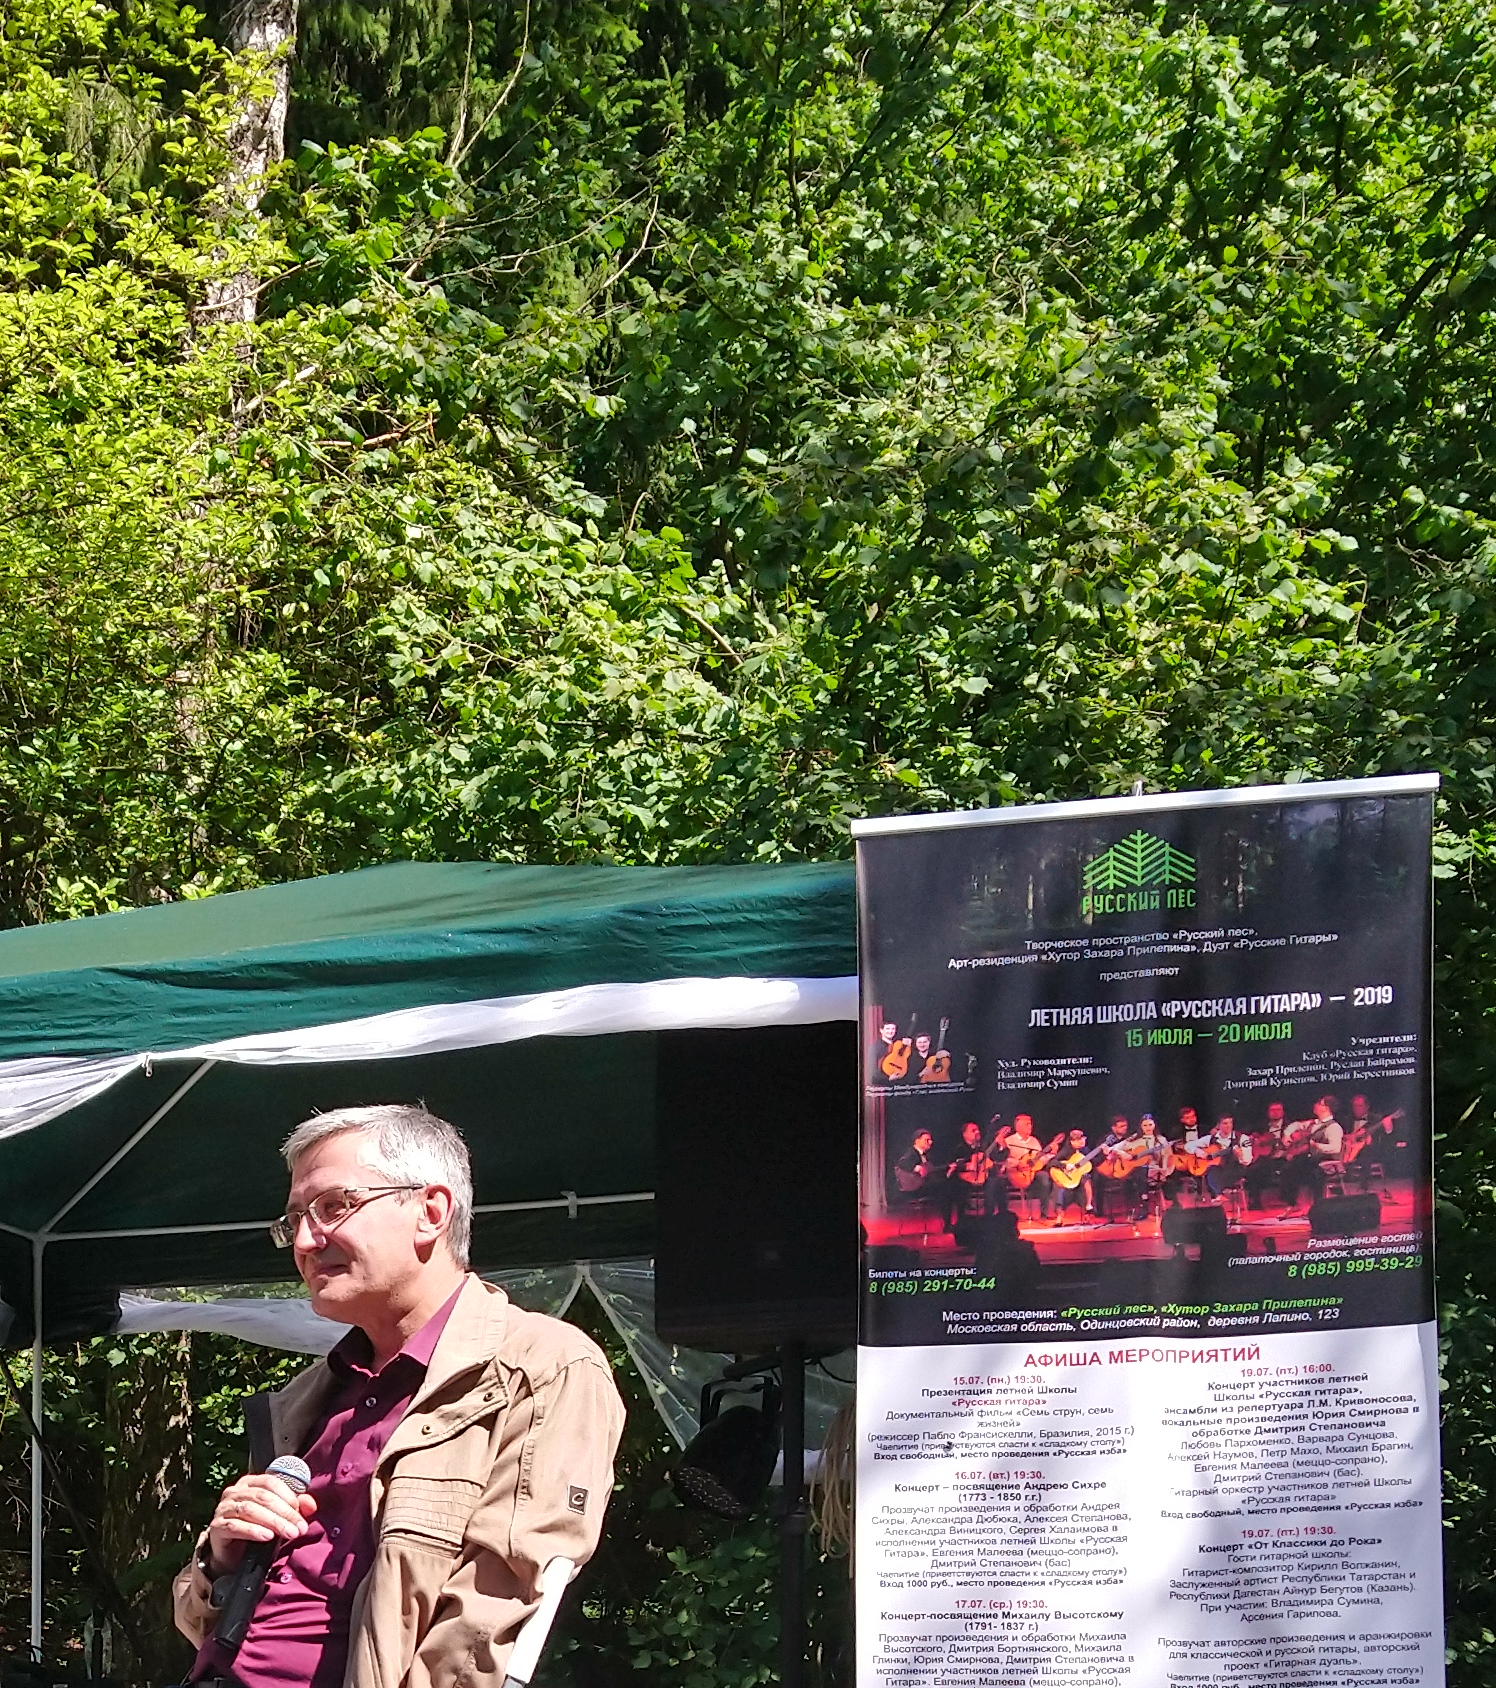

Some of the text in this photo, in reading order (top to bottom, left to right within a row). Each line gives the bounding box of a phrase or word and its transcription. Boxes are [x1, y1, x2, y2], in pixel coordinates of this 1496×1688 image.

[1081, 888, 1196, 915] РУССКИЙ ЛЕС
[1024, 938, 1088, 951] Творческое
[1092, 932, 1169, 947] пространство
[1172, 927, 1224, 942] «Русский
[948, 954, 1037, 970] Арт-резиденция
[1041, 951, 1080, 963] «Хутор
[1083, 948, 1123, 959] Захара
[1202, 940, 1229, 953] Дуэт
[1233, 937, 1285, 950] «Русские
[1289, 931, 1337, 945] Гитары»
[1099, 966, 1180, 982] представляют
[1028, 1004, 1092, 1028] ЛЕТНЯЯ
[1096, 1000, 1156, 1023] ШКОЛА
[1161, 994, 1246, 1019] «РУССКАЯ
[1250, 989, 1321, 1013] ГИТАРА»
[1353, 984, 1392, 1007] 2019
[1124, 1028, 1143, 1048] 15
[1145, 1026, 1192, 1047] ИЮЛЯ
[1216, 1023, 1240, 1043] 20
[1243, 1021, 1292, 1042] ИЮЛЯ
[1227, 1251, 1301, 1268] (палаточный
[868, 1268, 976, 1279] Билеты на концерты:
[1287, 1264, 1297, 1278] 8
[1301, 1261, 1340, 1278] (985)
[867, 1277, 995, 1295] 8 (985) 291-70-44
[942, 1311, 980, 1322] Место
[982, 1308, 1057, 1322] проведения:
[1060, 1303, 1120, 1318] «Русский
[1160, 1301, 1209, 1314] «Хутор
[1213, 1299, 1259, 1311] Захара
[1261, 1293, 1343, 1310] Прилепина»
[946, 1308, 1339, 1335] Московская область, Одинцовский район, деревня Лапино, 123
[1024, 1342, 1259, 1368] АФИША МЕРОПРИЯТИЙ
[1303, 1363, 1336, 1374] 16:00.
[953, 1374, 1045, 1386] 15.07. (пн.) 19:30.
[1208, 1380, 1254, 1391] Концерт
[1258, 1376, 1324, 1390] участников
[921, 1387, 992, 1398] Презентация
[1037, 1385, 1077, 1395] Школы
[1213, 1385, 1362, 1402] Школы «Русская гитара»,
[951, 1396, 1046, 1409] «Русская гитара»
[1013, 1469, 1045, 1480] 19:30.
[894, 1482, 939, 1494] Концерт
[1023, 1481, 1068, 1492] Андрею
[958, 1492, 986, 1503] (1773
[997, 1492, 1021, 1501] 1850
[1303, 1525, 1335, 1536] 19:30.
[1198, 1544, 1242, 1554] Концерт
[1272, 1540, 1326, 1550] Классики
[1329, 1539, 1344, 1549] до
[1348, 1536, 1381, 1547] Рока»
[954, 1599, 1047, 1611] 17.07. (ср.) 19:30.
[880, 1610, 1124, 1622] Концерт-посвящение Михаилу Высотскому
[1001, 1622, 1023, 1631] 1837
[1028, 1622, 1038, 1632] г.)
